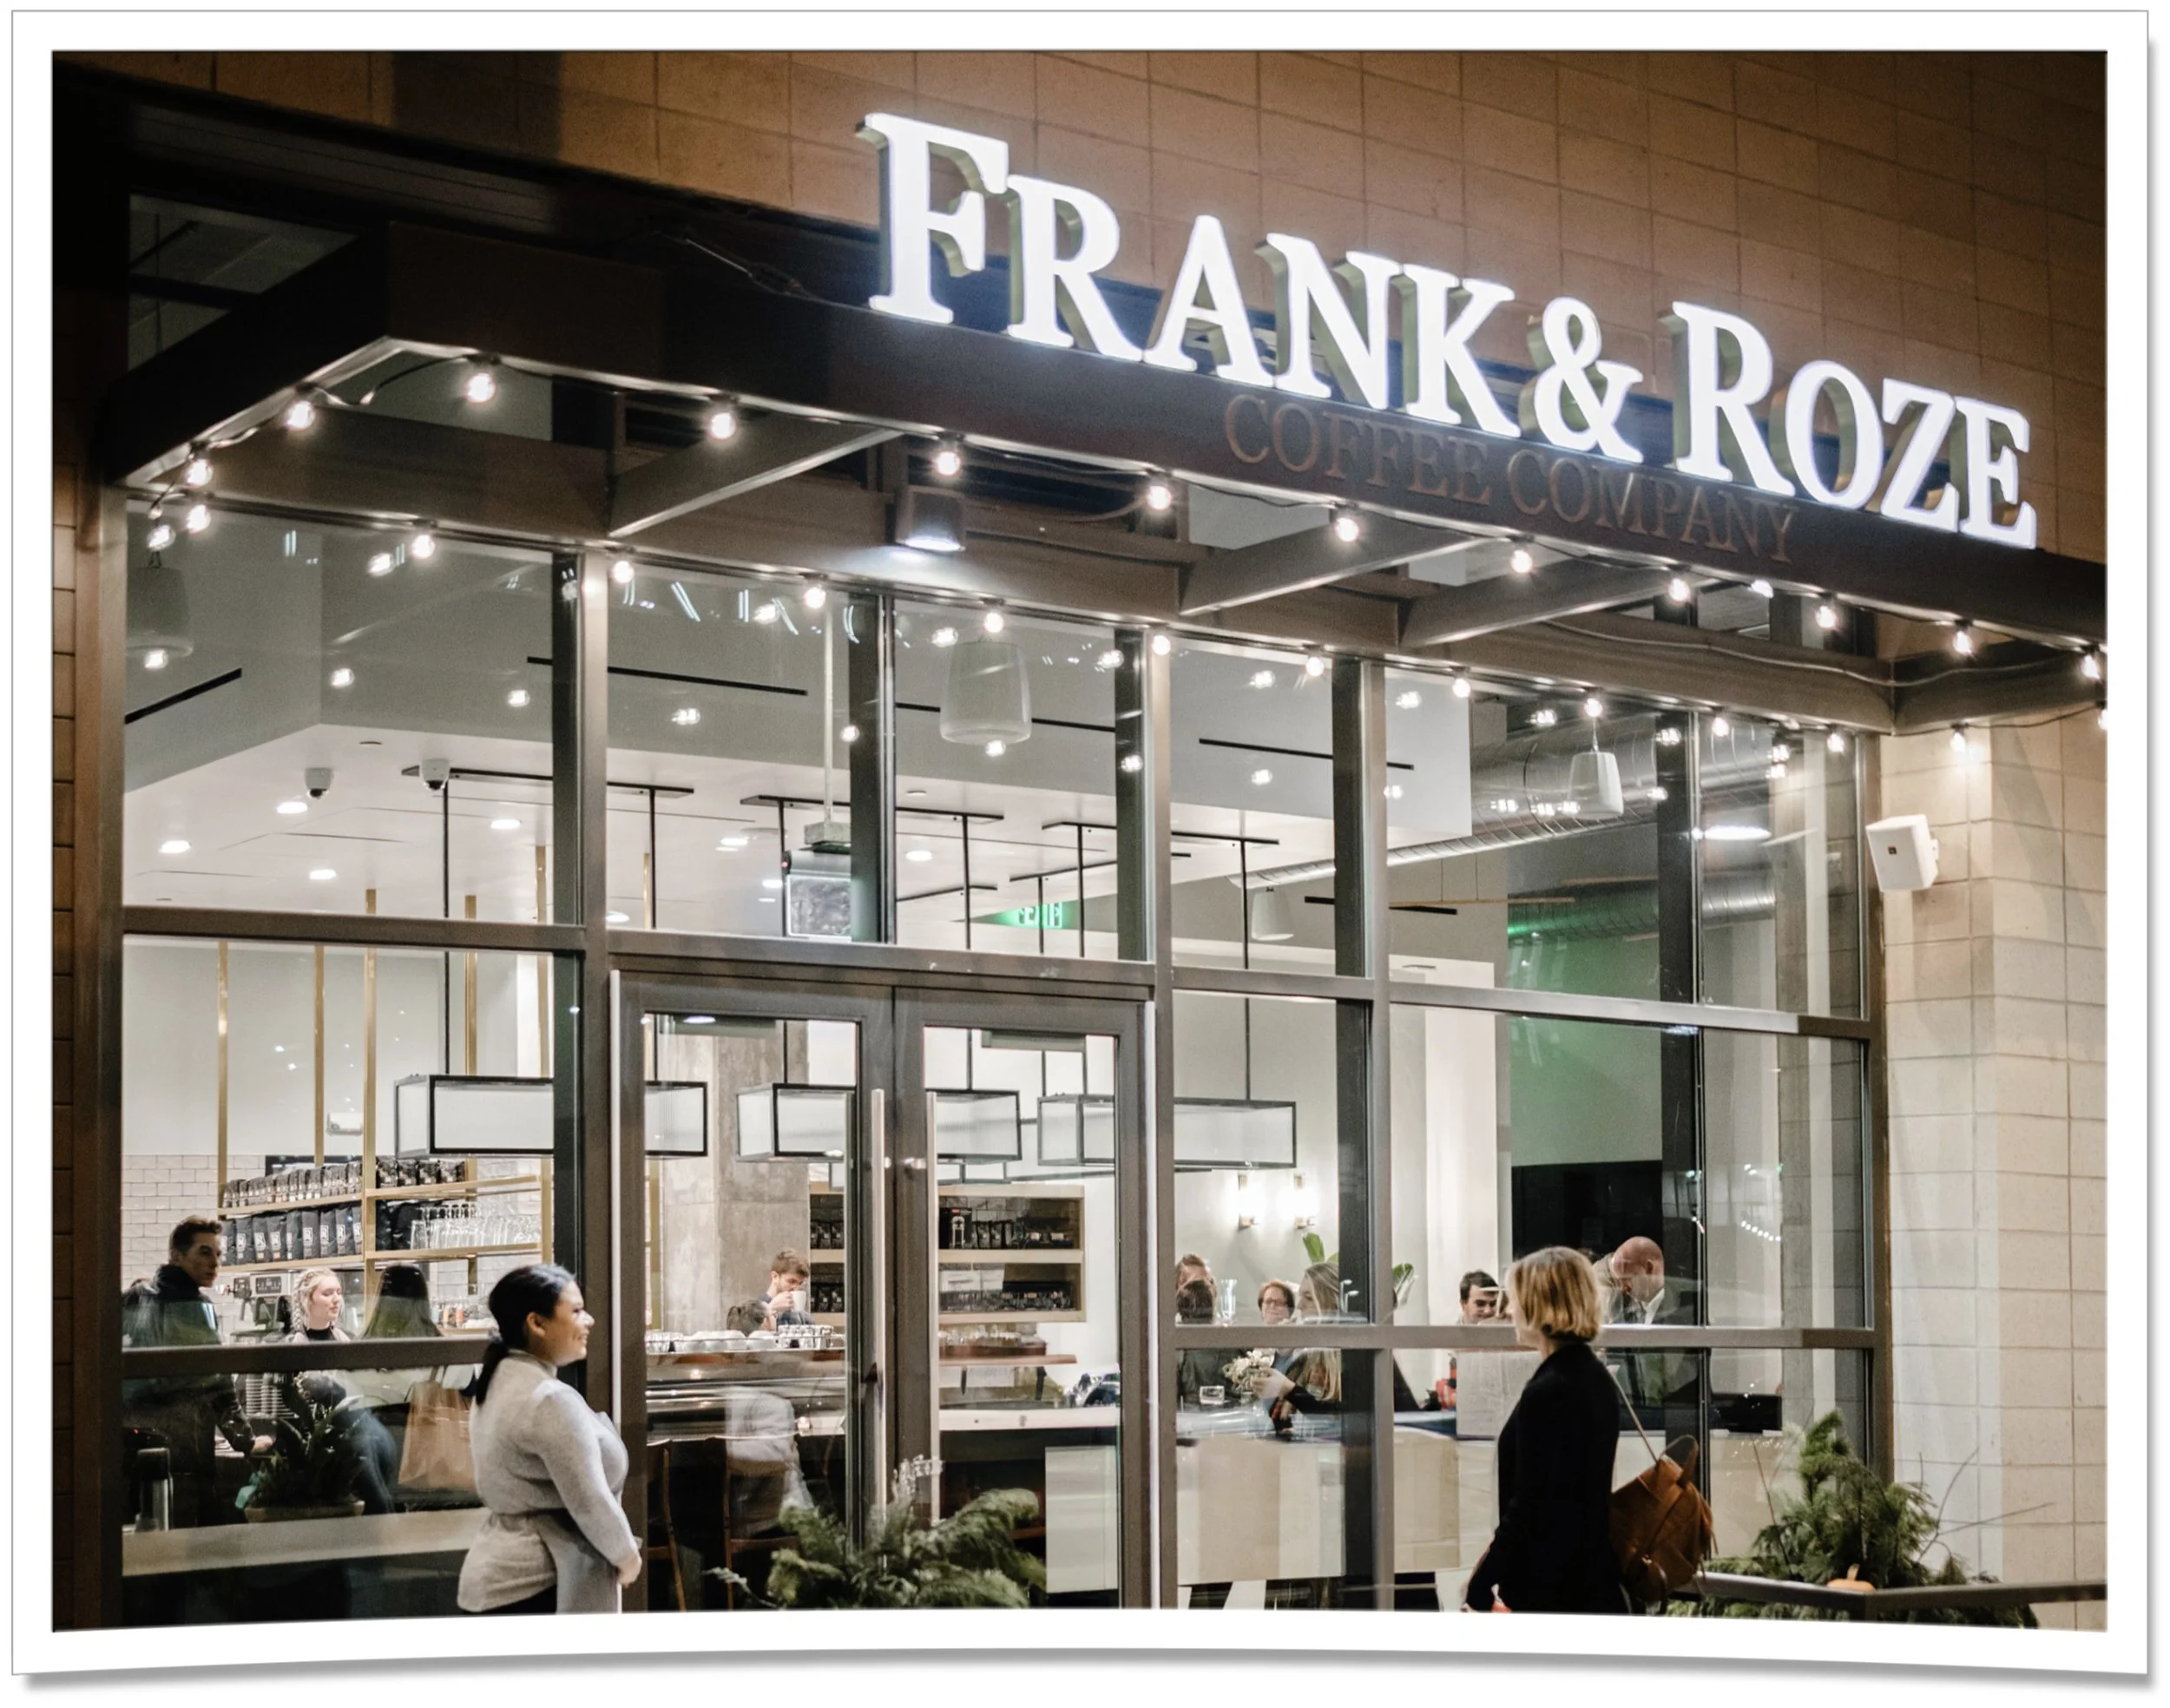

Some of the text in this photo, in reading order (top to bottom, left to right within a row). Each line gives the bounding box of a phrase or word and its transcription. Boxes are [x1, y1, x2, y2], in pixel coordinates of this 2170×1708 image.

[864, 112, 2037, 550] FRANK & ROZE
[1225, 393, 1800, 564] COFFEE COMPANY
